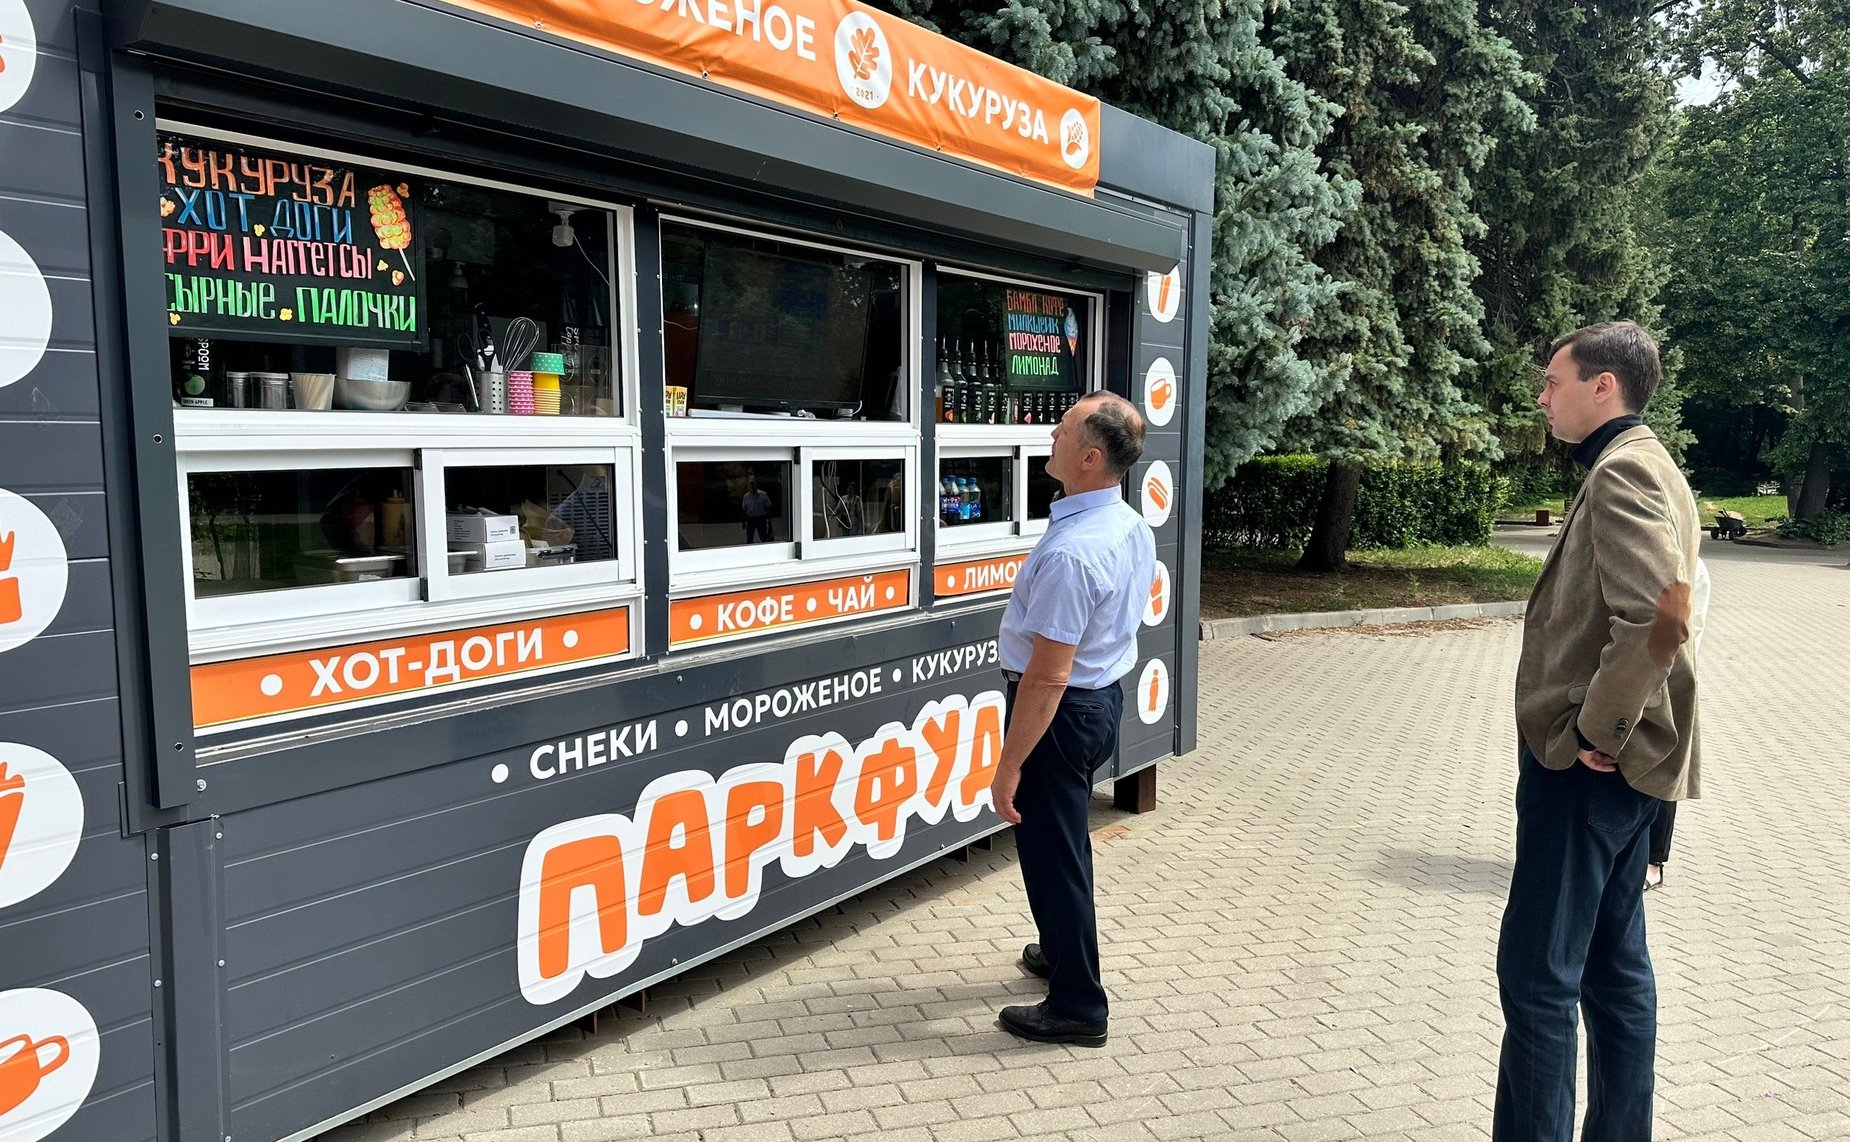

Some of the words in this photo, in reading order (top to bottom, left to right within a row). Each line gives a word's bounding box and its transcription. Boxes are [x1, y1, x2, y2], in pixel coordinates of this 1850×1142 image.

[855, 87, 875, 100] 2021
[908, 57, 1049, 145] КУКУРУЗА
[175, 187, 256, 232] ХОТ
[269, 198, 353, 244] ДОГИ
[295, 287, 416, 332] ПАЛОЧКИ
[1042, 295, 1065, 317] КОФЕ
[1011, 354, 1060, 376] ЛИМОНАД
[717, 594, 795, 632] КОФЕ
[828, 575, 876, 613] ЧАЙ
[308, 627, 543, 697] ХОТ-ДОГИ
[529, 718, 658, 781] СНЕКИ
[704, 666, 883, 737] МОРОЖЕНОЕ
[911, 639, 1000, 684] КУКУРУЗ
[537, 704, 1003, 980] ПАРКФУД
